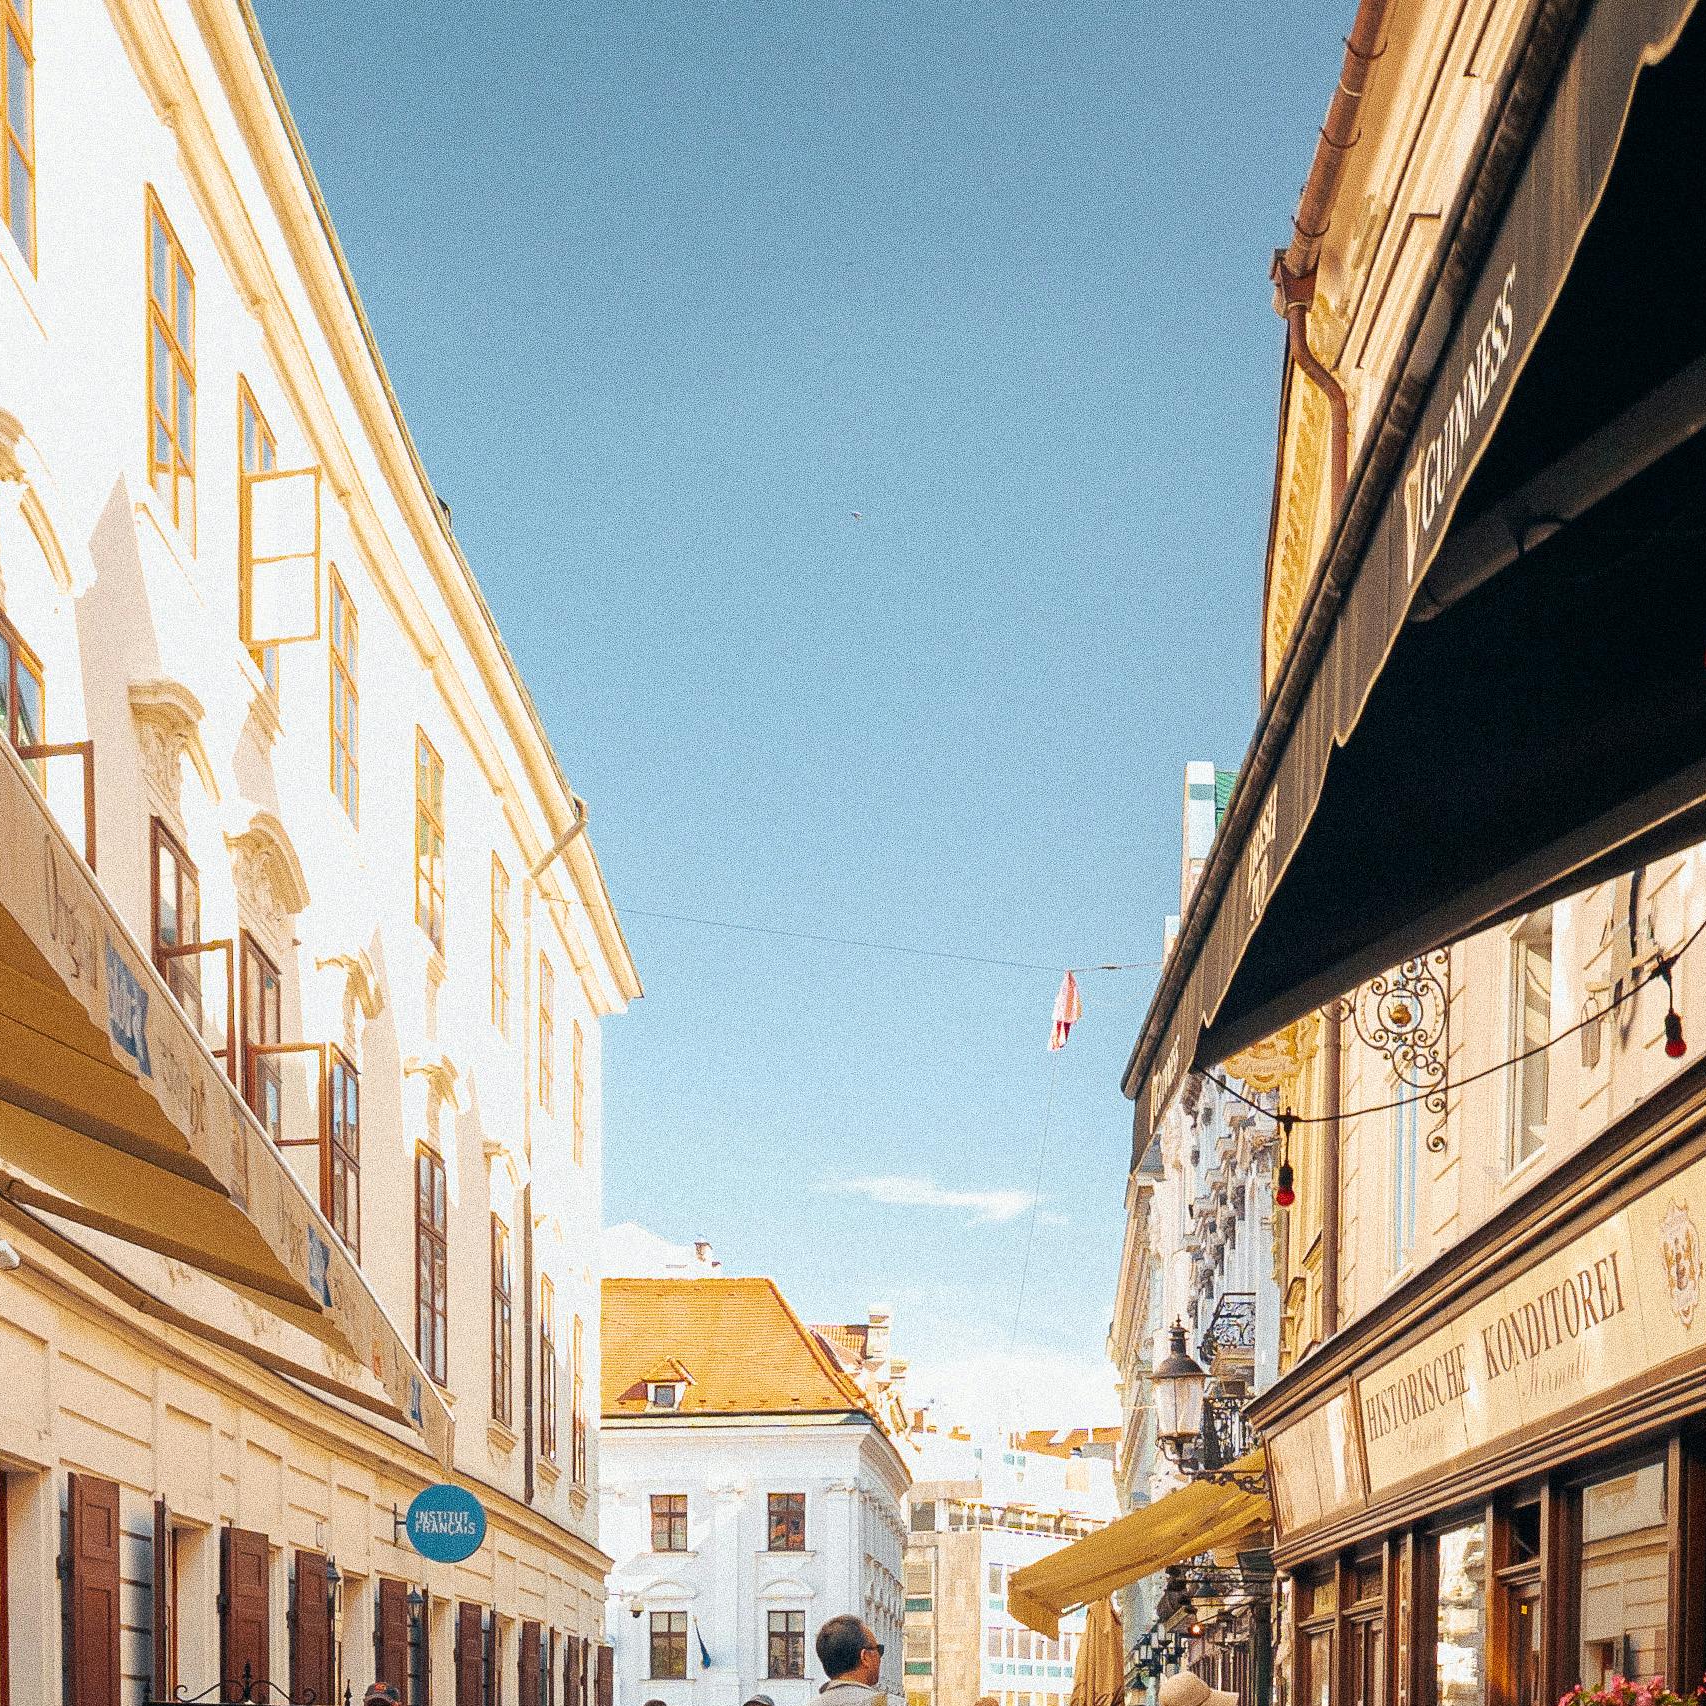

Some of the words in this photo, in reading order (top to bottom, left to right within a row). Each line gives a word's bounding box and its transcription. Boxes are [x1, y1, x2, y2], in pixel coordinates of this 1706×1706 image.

[1420, 261, 1517, 532] GUINNESS
[1364, 1342, 1471, 1443] HISTORISCHE
[1481, 1250, 1626, 1380] KONDITOREI
[414, 1510, 470, 1523] INSTITUT
[414, 1522, 476, 1536] FRANÇAIS
